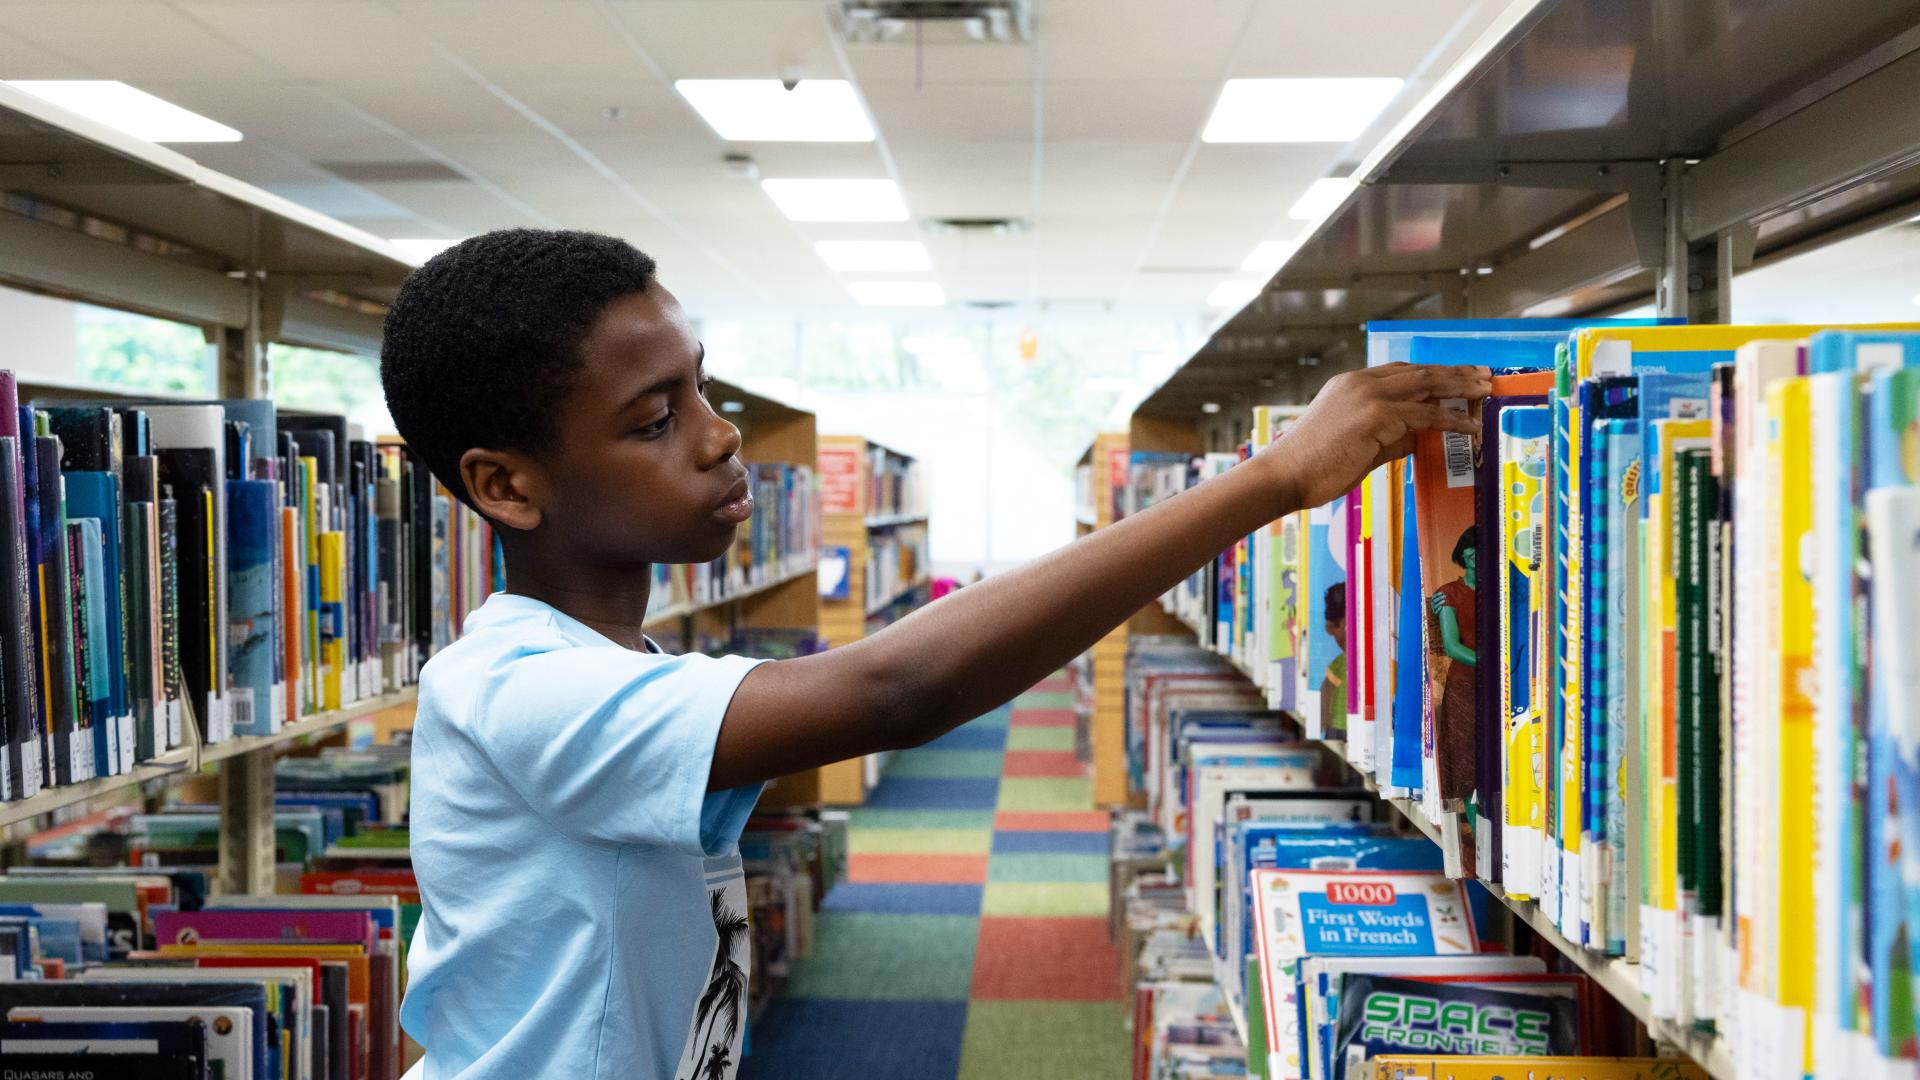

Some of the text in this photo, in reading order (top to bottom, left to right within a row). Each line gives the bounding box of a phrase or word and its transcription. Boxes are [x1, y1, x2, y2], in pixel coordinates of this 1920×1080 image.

[1625, 464, 1640, 496] QUEST
[1566, 693, 1577, 783] WORK
[1333, 883, 1392, 903] 1000
[1307, 908, 1424, 927] First Words
[1320, 926, 1417, 944] in French
[1364, 992, 1551, 1042] SPACE
[4, 1070, 94, 1080] QUASARS AND
